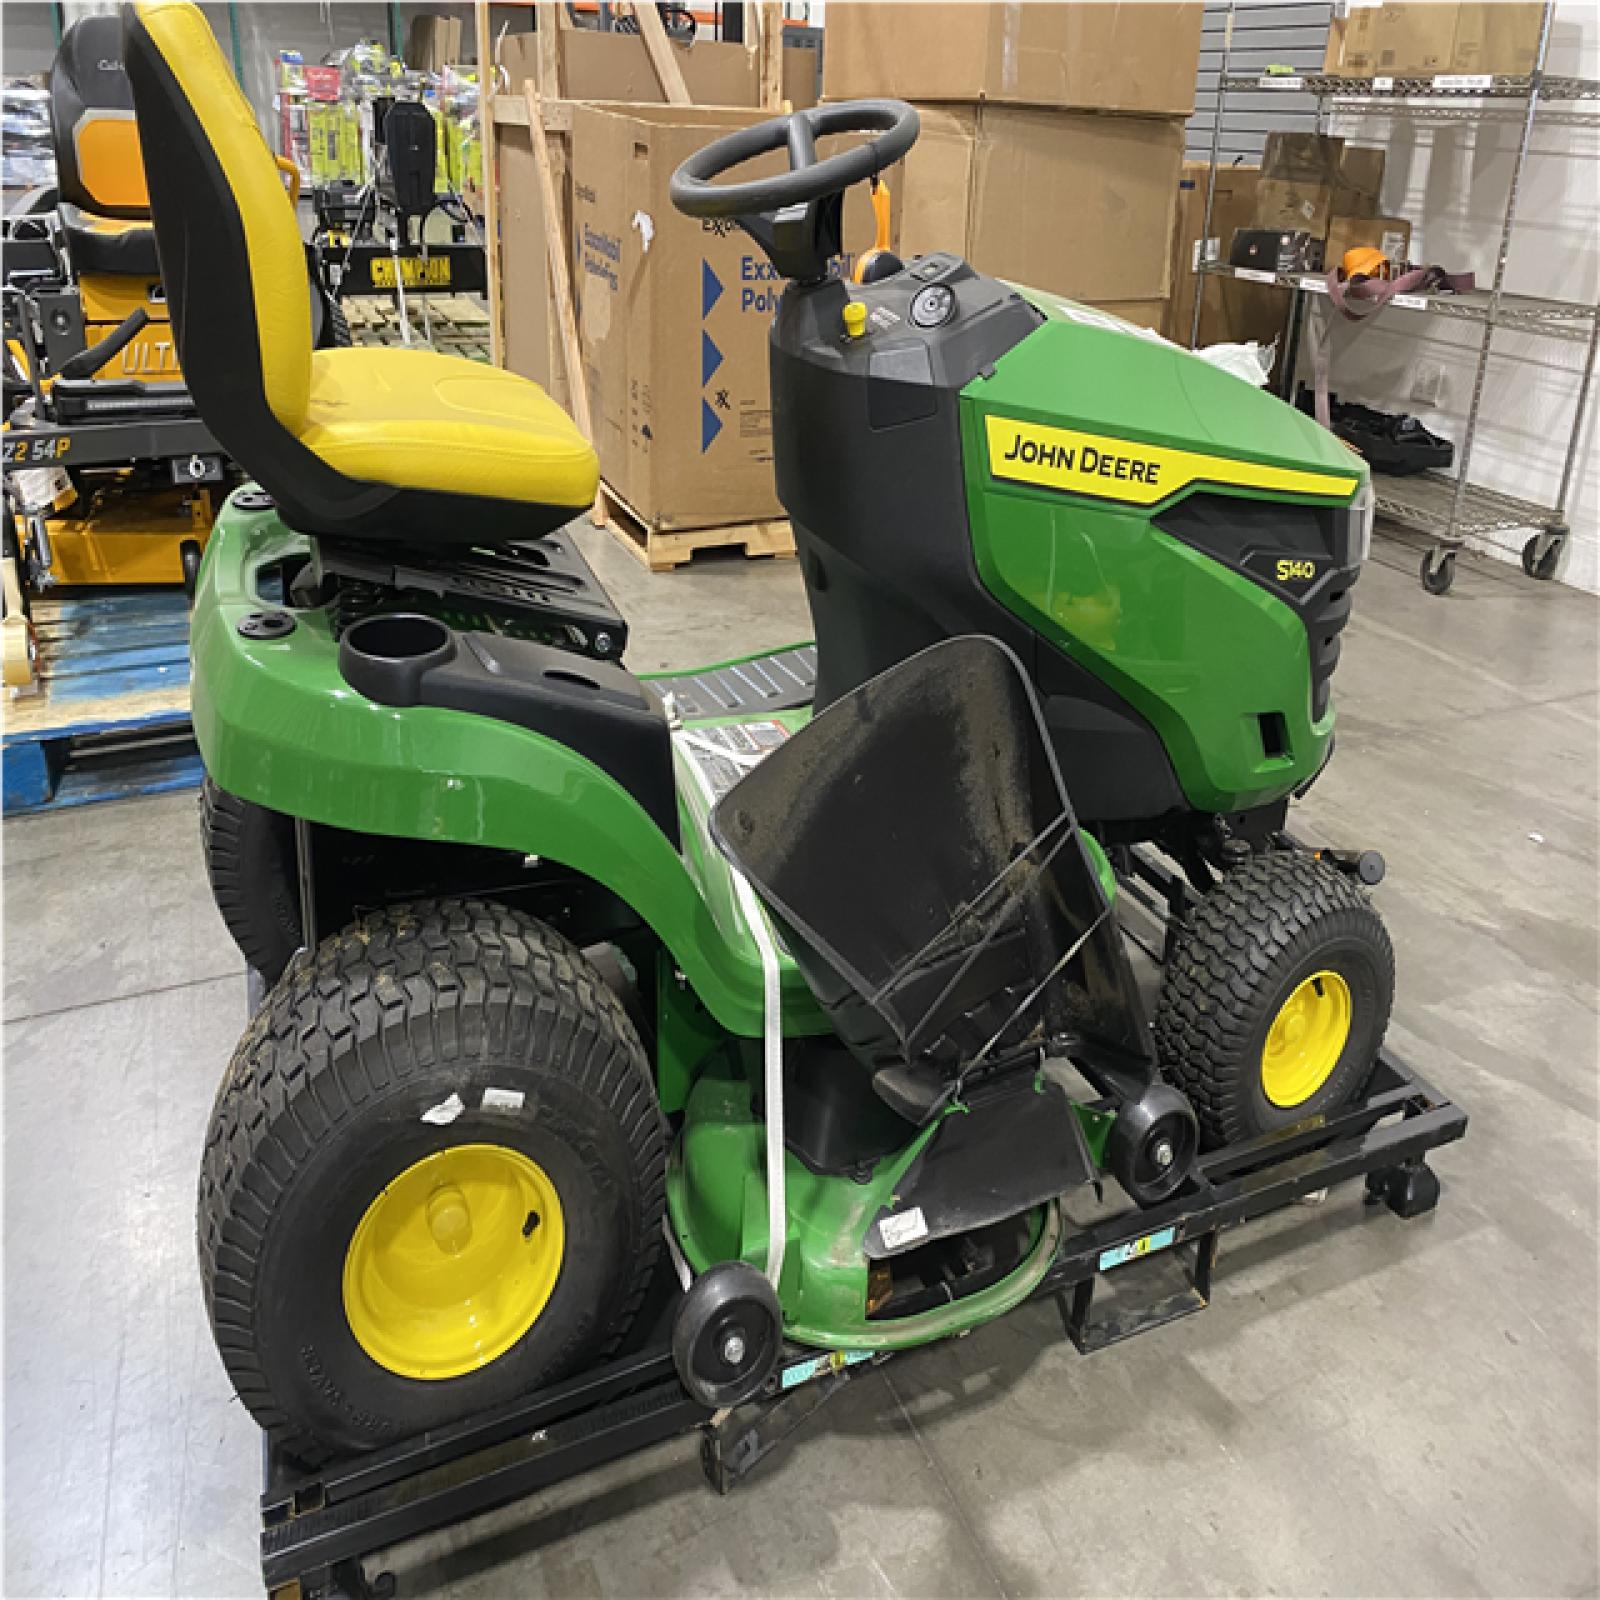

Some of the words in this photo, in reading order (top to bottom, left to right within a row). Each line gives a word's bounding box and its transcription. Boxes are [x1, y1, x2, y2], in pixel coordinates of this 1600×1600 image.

[32, 437, 71, 461] 54P
[1004, 433, 1076, 471] JOHN
[1080, 446, 1161, 486] DEERE
[1276, 559, 1316, 581] S140
